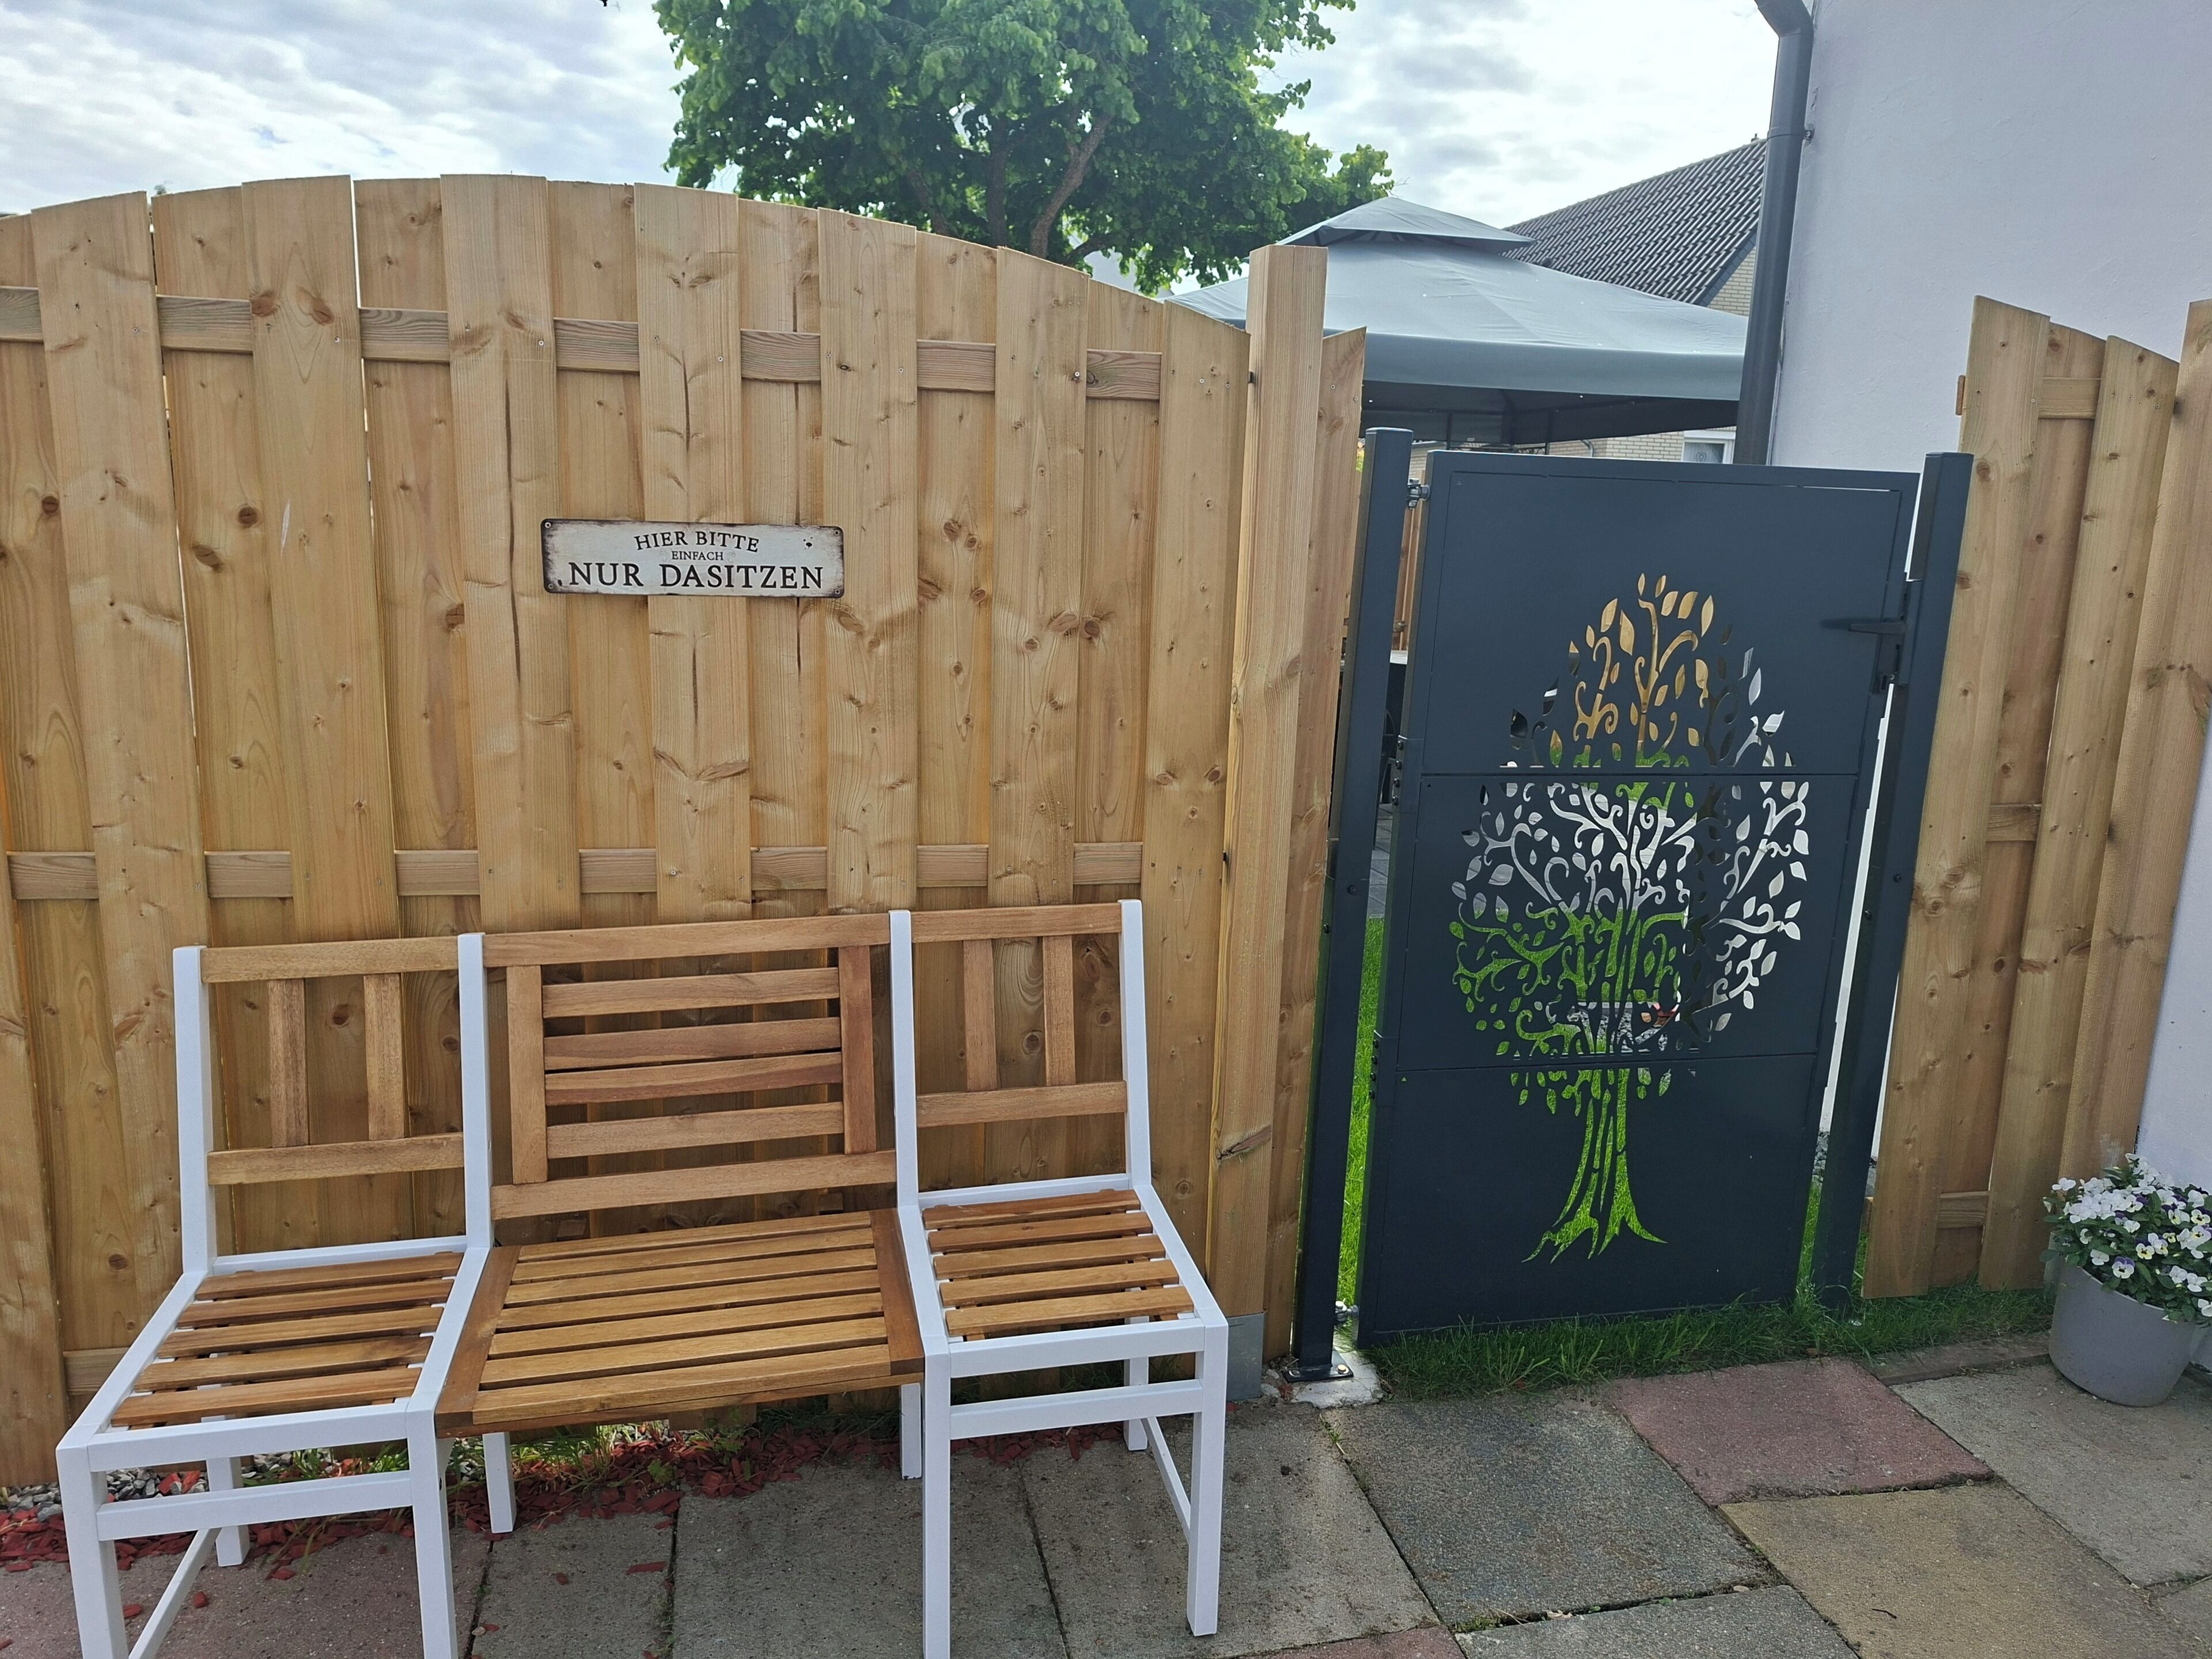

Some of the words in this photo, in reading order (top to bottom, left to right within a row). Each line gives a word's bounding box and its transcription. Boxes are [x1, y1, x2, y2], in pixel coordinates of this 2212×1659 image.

[634, 531, 688, 551] HIER
[695, 531, 759, 553] BITTE
[671, 550, 724, 561] EINFACH
[568, 562, 644, 586] NUR
[660, 563, 824, 589] DASITZEN
